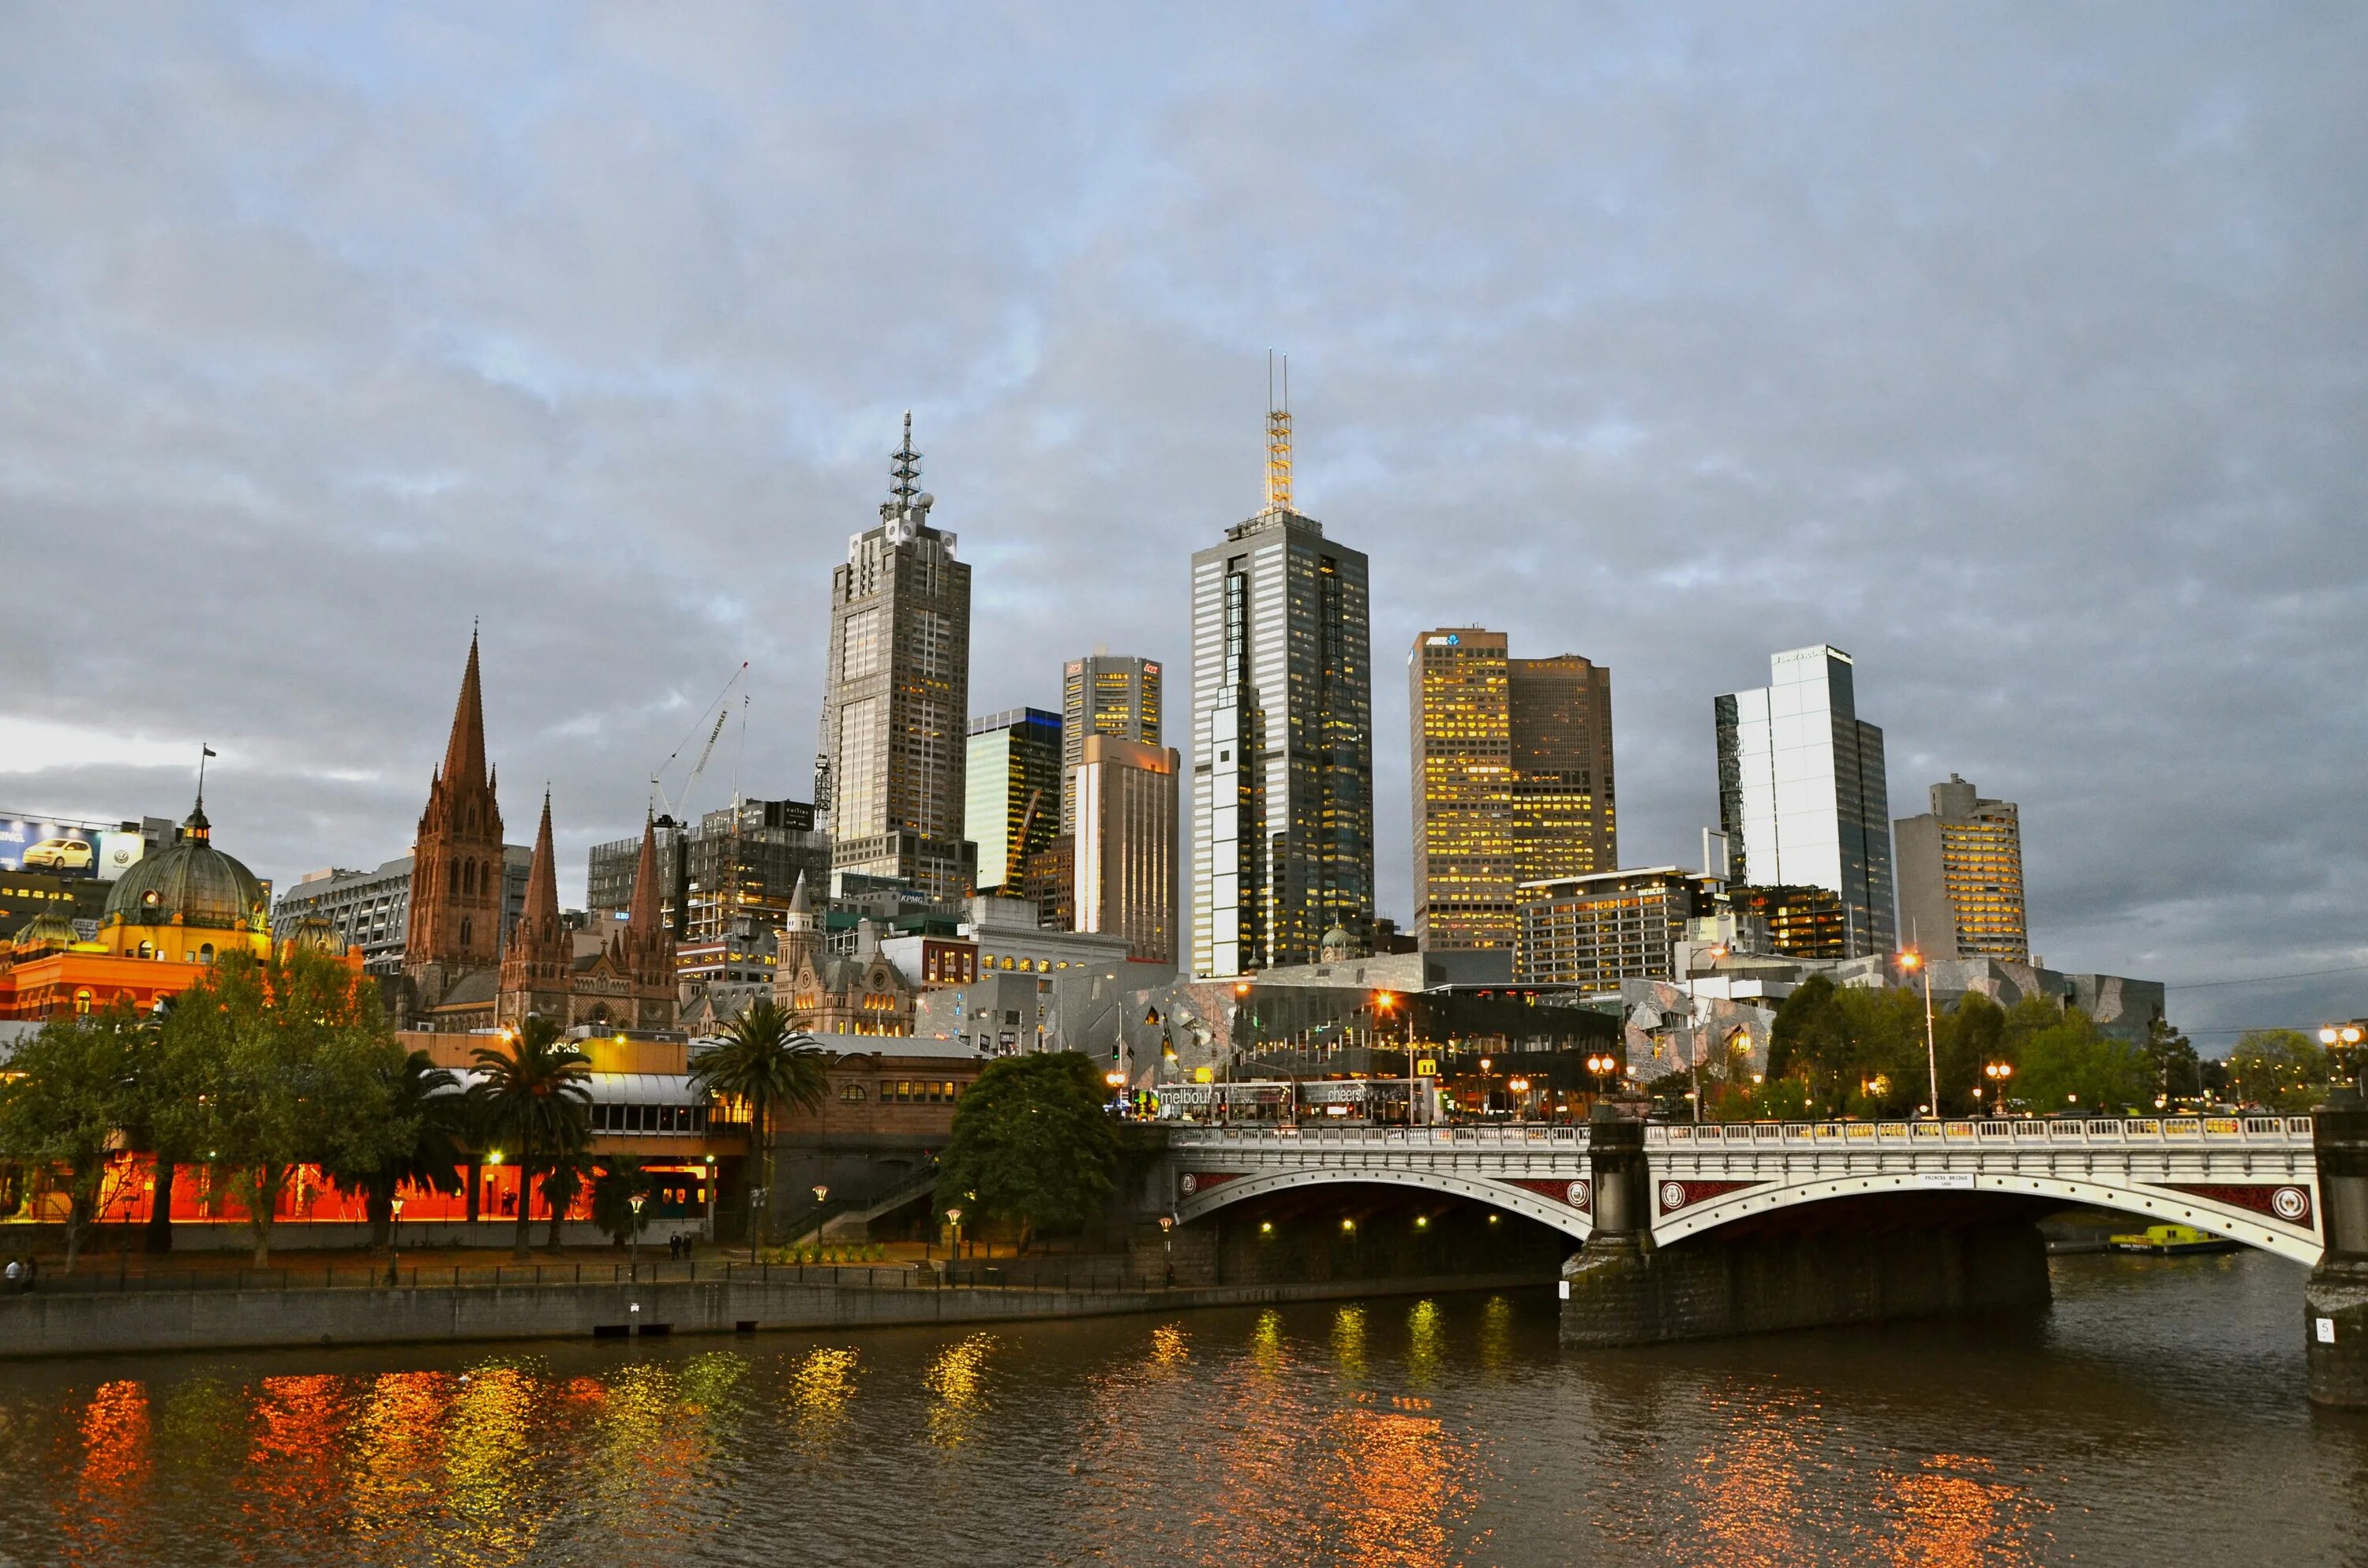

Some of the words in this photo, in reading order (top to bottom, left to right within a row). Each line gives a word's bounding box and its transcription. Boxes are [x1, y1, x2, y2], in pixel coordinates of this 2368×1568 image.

[901, 895, 924, 904] KPMG
[1160, 1089, 1227, 1104] melbourn
[1328, 1086, 1365, 1102] cheers!
[2322, 1323, 2329, 1333] 5
